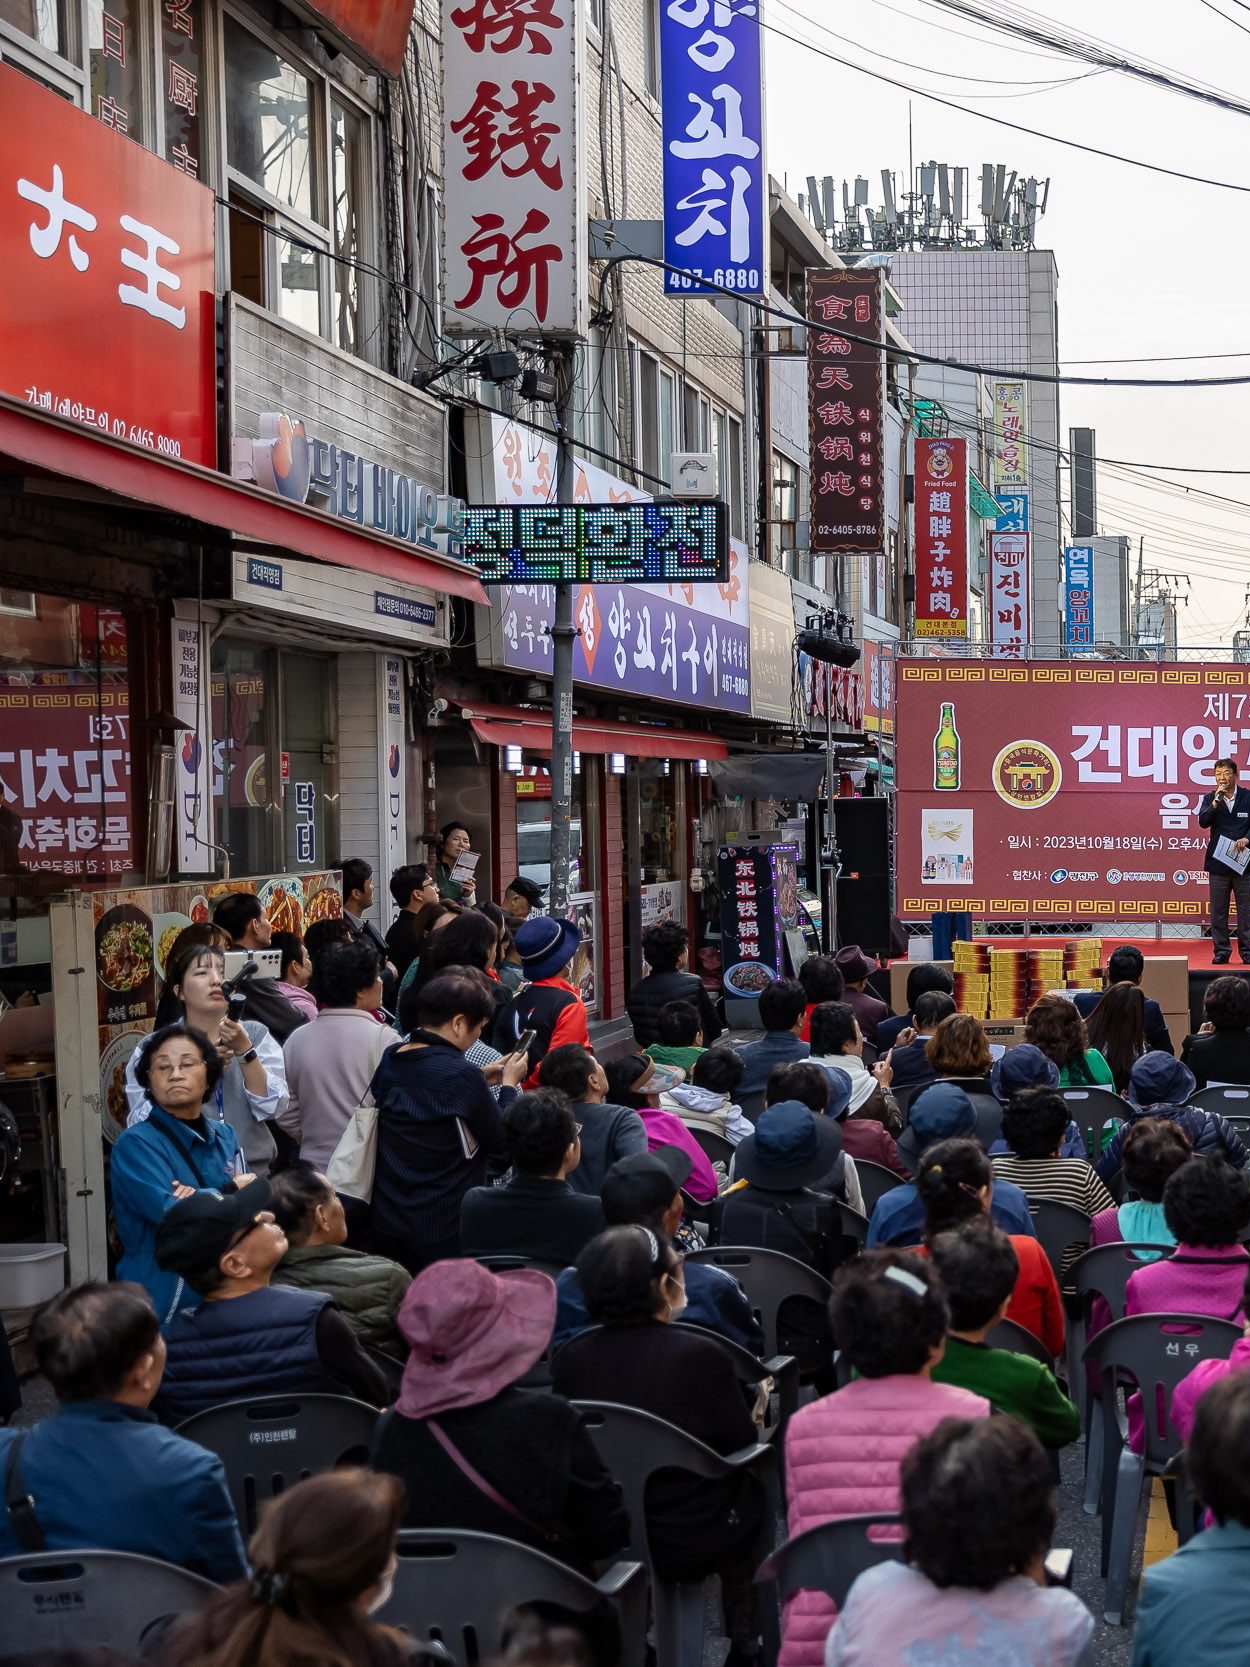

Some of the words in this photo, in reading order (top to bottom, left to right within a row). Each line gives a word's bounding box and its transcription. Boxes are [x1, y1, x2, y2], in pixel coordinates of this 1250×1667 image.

[669, 269, 758, 289] 467-6880
[858, 409, 872, 510] 식위천식당
[818, 525, 877, 537] 02-6405-8786
[929, 491, 953, 613] 趙胖子炸肉
[997, 552, 1022, 565] 진미
[252, 564, 280, 585] 건대직영점
[377, 596, 399, 614] 체인점문의
[926, 621, 957, 629] 건대본점
[1070, 590, 1090, 643] 양꼬치
[504, 609, 555, 655] 선두주
[917, 629, 965, 637] 02)462-5358
[608, 589, 718, 697] 양꼬치구이
[182, 647, 197, 661] 전용
[1007, 836, 1032, 850] 일시
[1043, 836, 1163, 850] 2023년10월18일(수)
[1012, 870, 1042, 881] 협찬사
[1069, 871, 1098, 881] 광진구
[1188, 871, 1209, 880] TSIN
[735, 860, 760, 958] 东北铁锅炖
